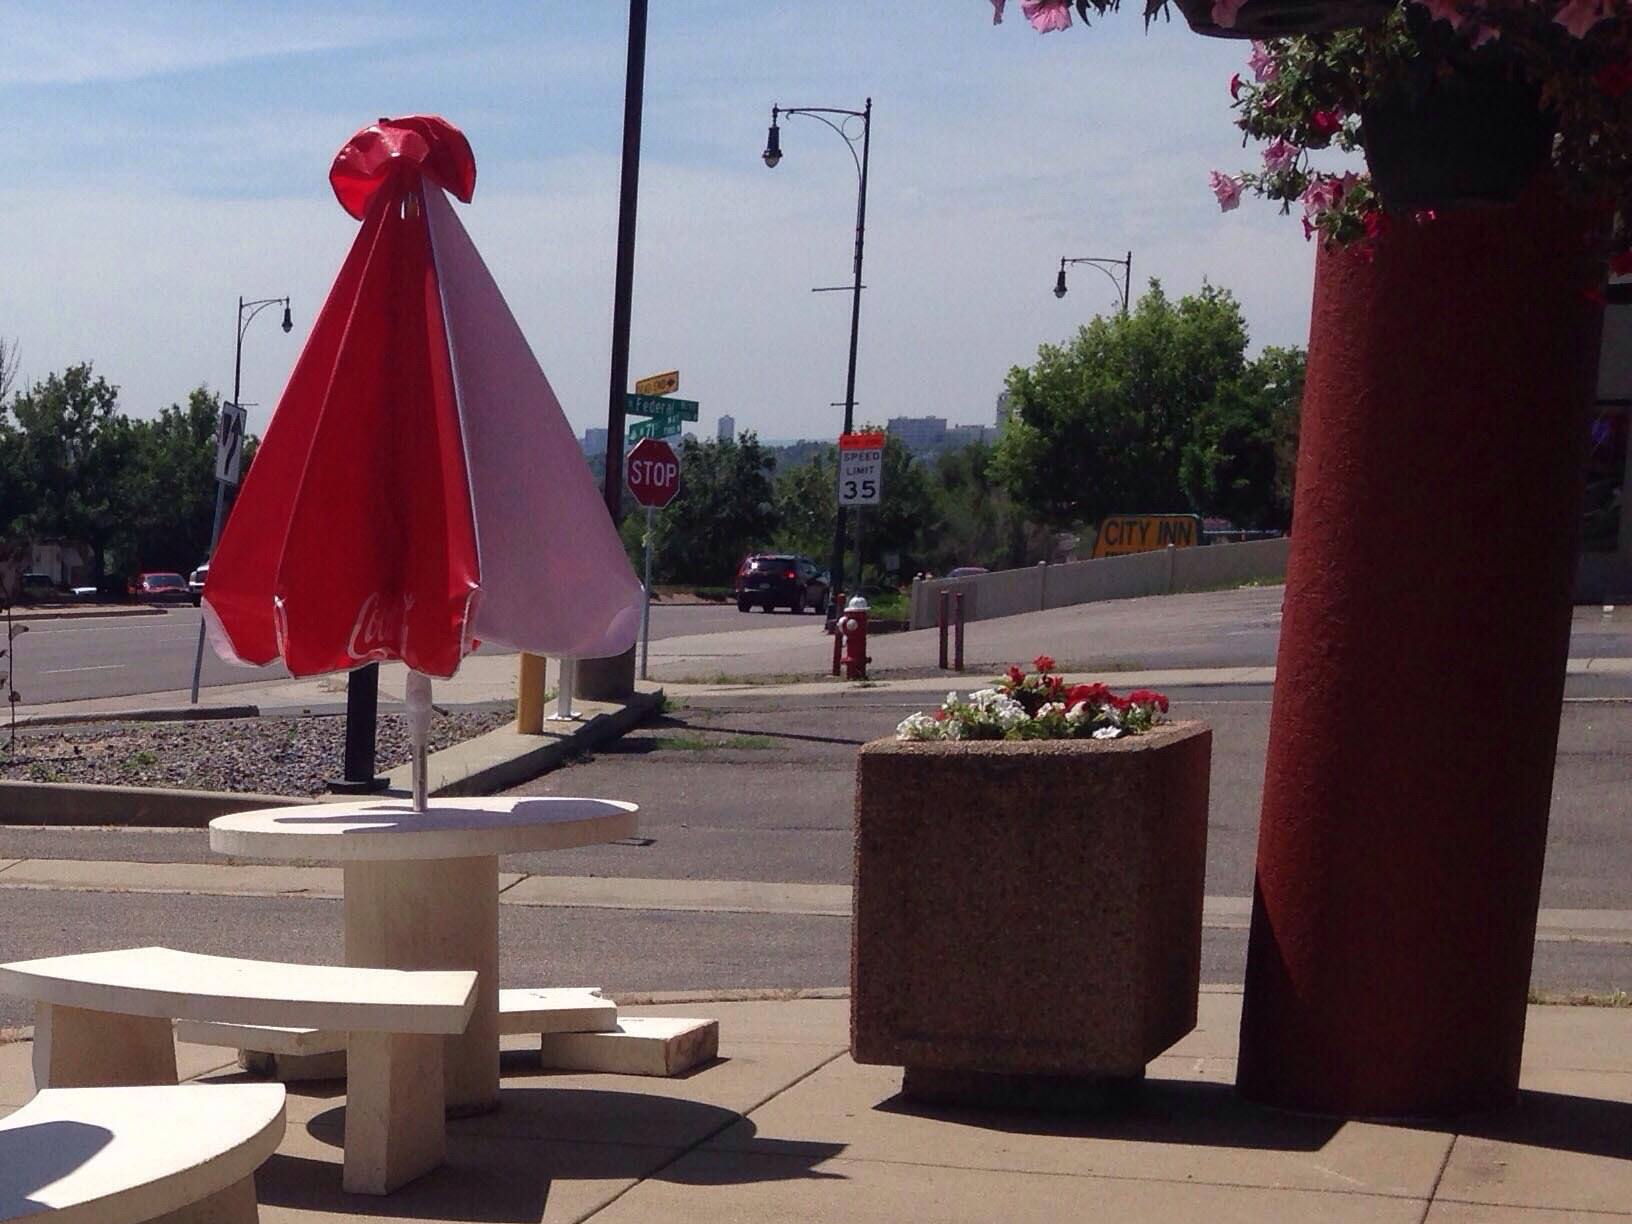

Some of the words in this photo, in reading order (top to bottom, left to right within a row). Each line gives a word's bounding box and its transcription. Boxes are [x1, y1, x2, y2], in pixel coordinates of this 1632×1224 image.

[636, 397, 674, 416] Federal
[843, 451, 880, 462] SPEED
[631, 460, 677, 487] STOP
[846, 465, 874, 476] LIMIT
[843, 480, 876, 500] 35
[1104, 520, 1151, 546] CITY
[1159, 520, 1194, 546] INN
